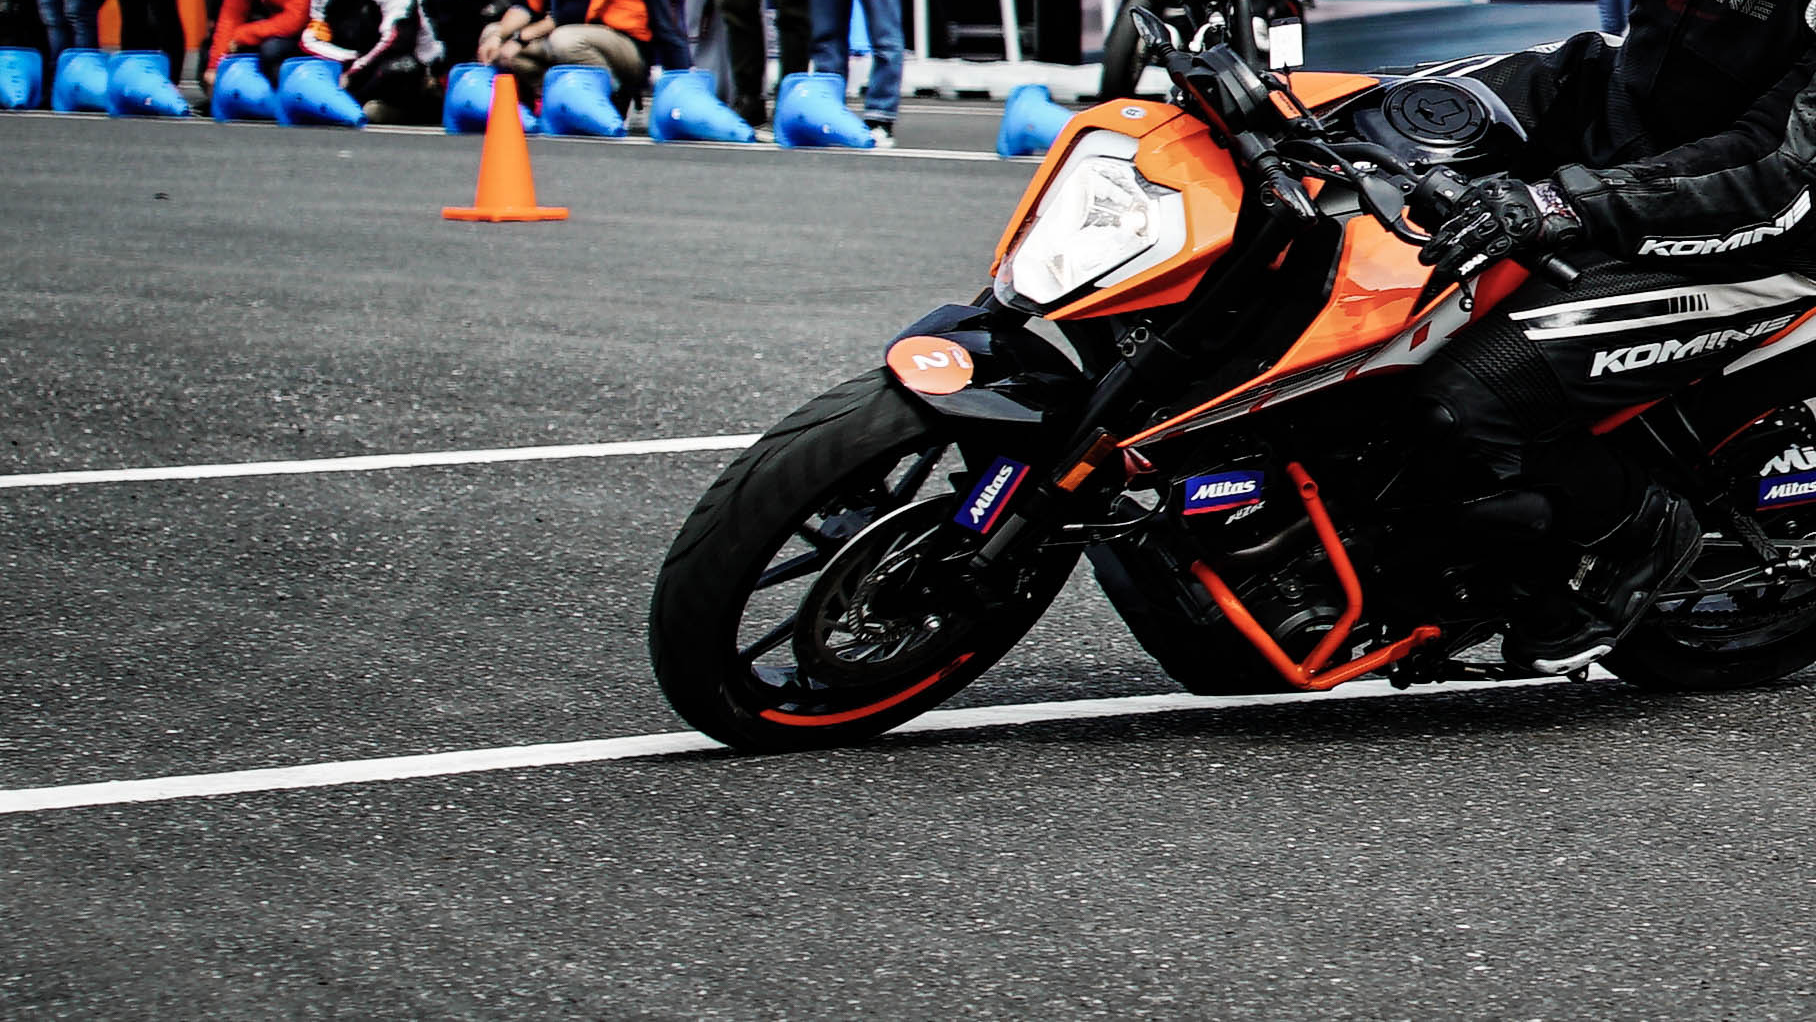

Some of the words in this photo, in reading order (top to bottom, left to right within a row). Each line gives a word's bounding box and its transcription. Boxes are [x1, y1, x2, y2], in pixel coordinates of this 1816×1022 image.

[1637, 189, 1812, 257] KOMINE
[911, 351, 950, 371] 2
[1589, 313, 1796, 378] KOMINE
[968, 464, 1015, 525] Mitas
[1190, 479, 1257, 502] Mitas
